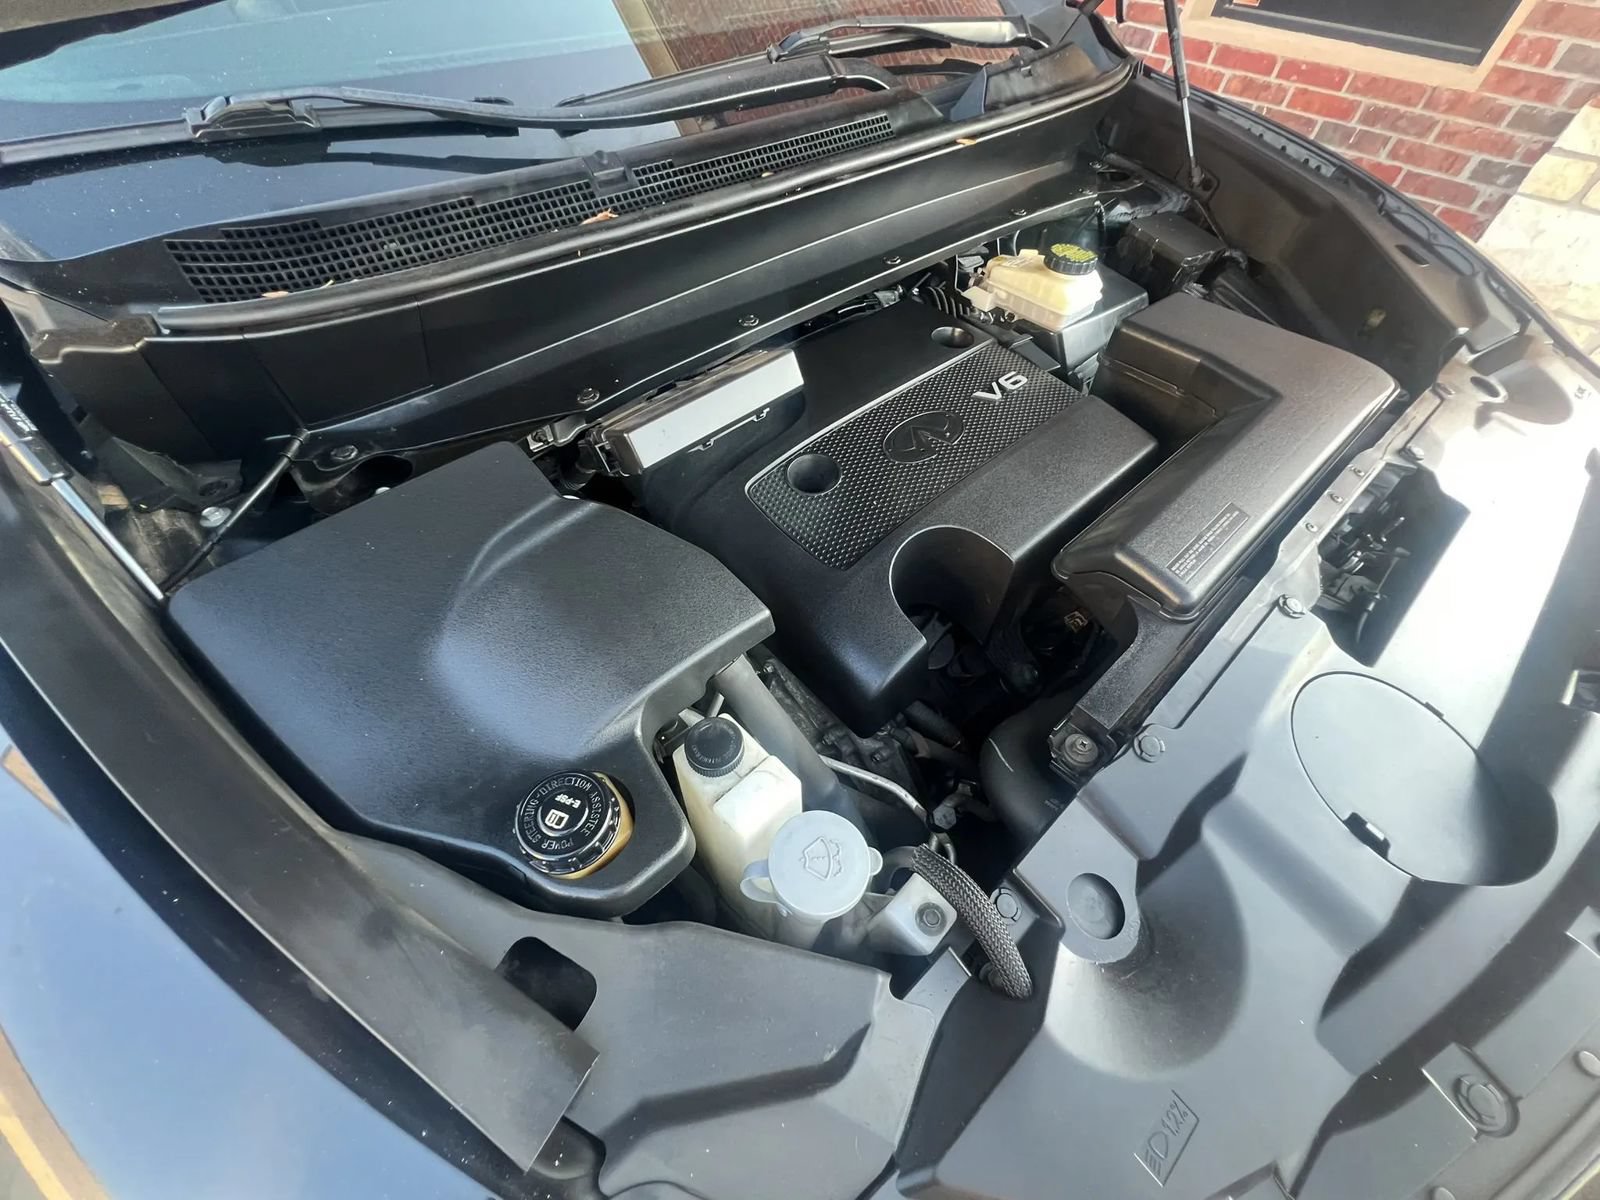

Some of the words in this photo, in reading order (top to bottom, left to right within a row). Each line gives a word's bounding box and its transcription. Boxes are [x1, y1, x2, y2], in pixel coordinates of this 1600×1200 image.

[971, 371, 1028, 400] V6
[555, 793, 581, 809] E-PSF
[541, 837, 575, 850] POWER
